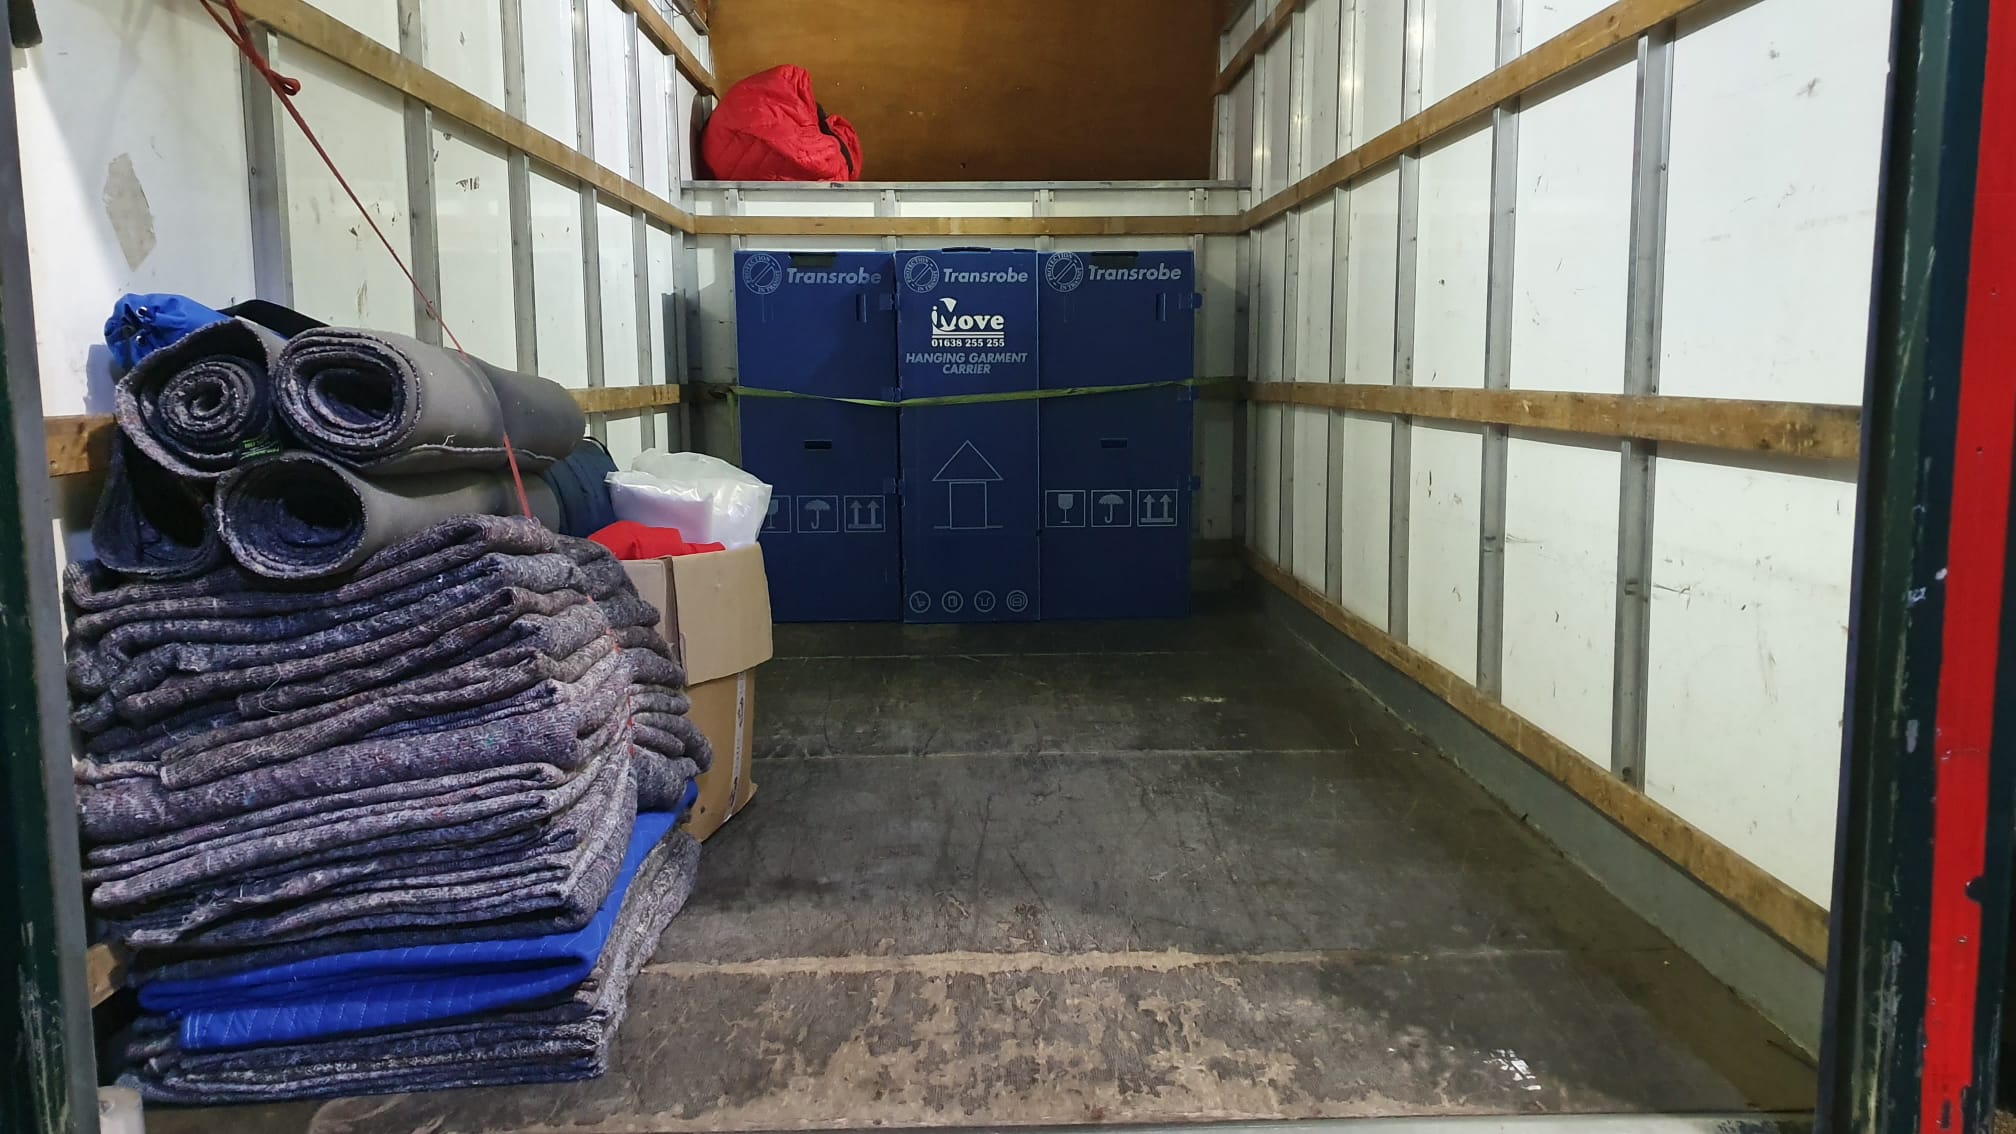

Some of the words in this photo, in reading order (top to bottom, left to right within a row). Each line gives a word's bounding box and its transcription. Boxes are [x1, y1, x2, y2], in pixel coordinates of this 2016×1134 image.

[787, 267, 882, 284] Transrobe
[943, 267, 1028, 283] Transrobe
[1088, 263, 1182, 281] Transrobe
[931, 338, 963, 348] 01638
[966, 338, 983, 348] 255
[987, 338, 1005, 348] 255
[905, 352, 966, 364] HANGING
[968, 352, 1028, 363] GARMENT
[942, 363, 991, 375] CARRIER
